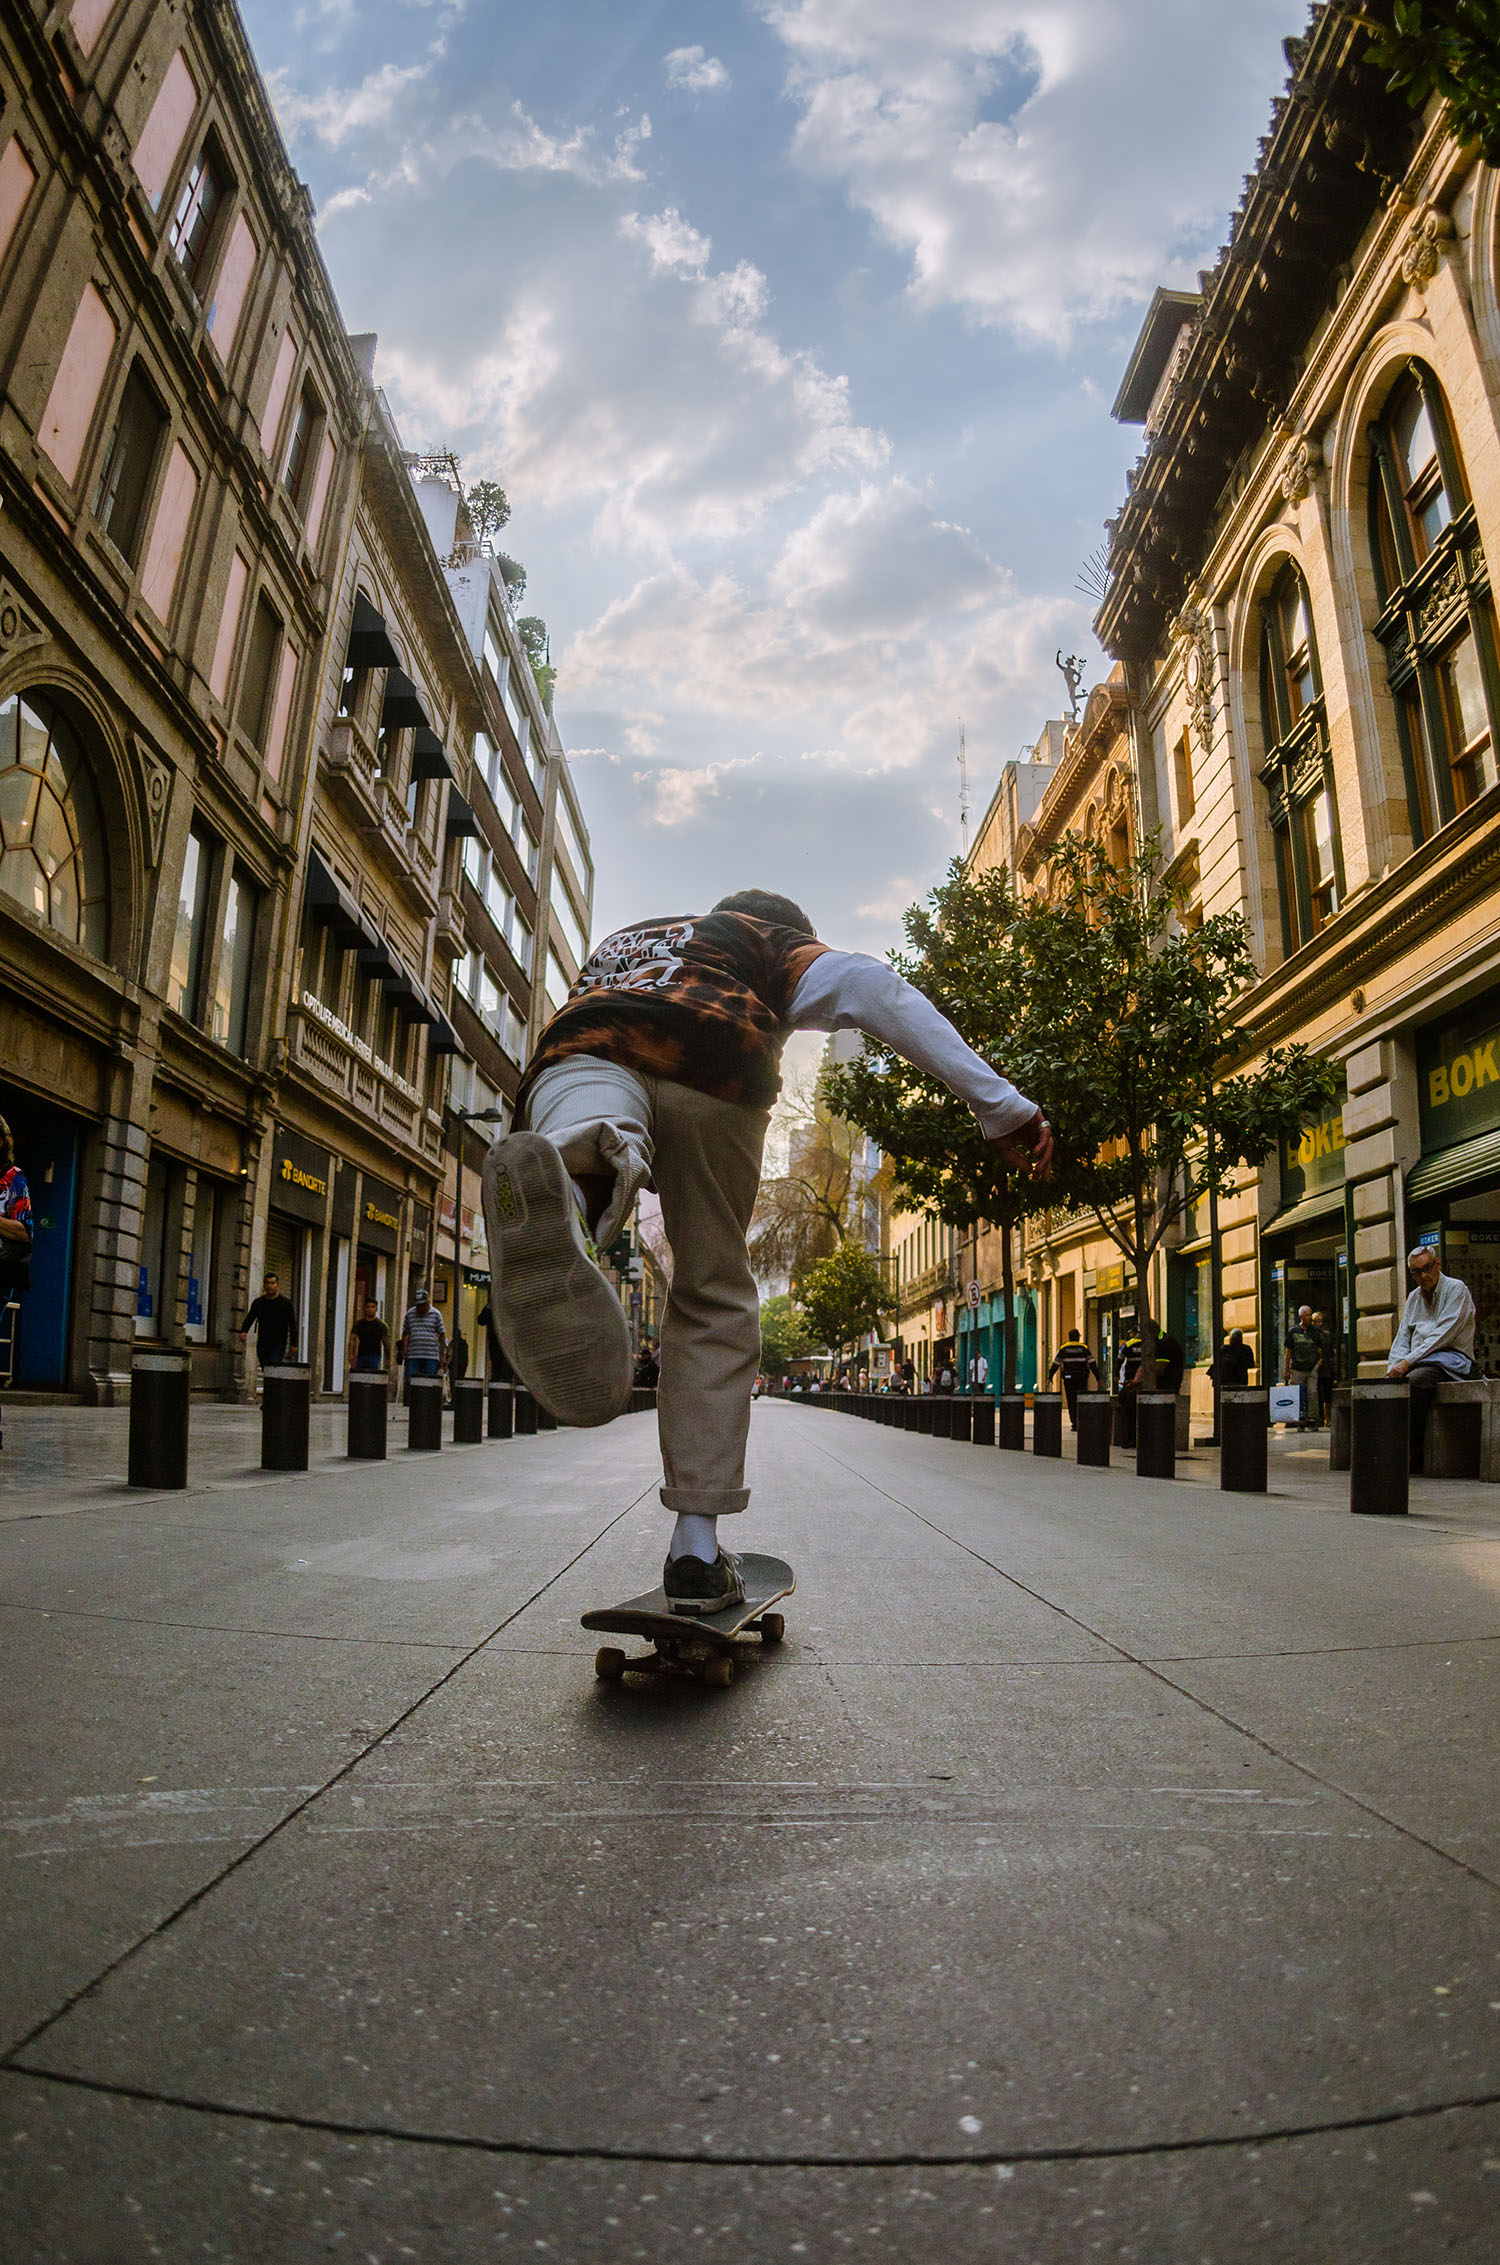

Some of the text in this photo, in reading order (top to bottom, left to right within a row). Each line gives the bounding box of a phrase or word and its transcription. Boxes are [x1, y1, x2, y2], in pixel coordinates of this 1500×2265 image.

[303, 990, 332, 1027] OPTOLIFE
[1429, 1039, 1500, 1108] BOK
[1287, 1116, 1351, 1170] BOKE
[292, 1168, 327, 1196] BANORTE
[374, 1209, 399, 1230] BANORTE
